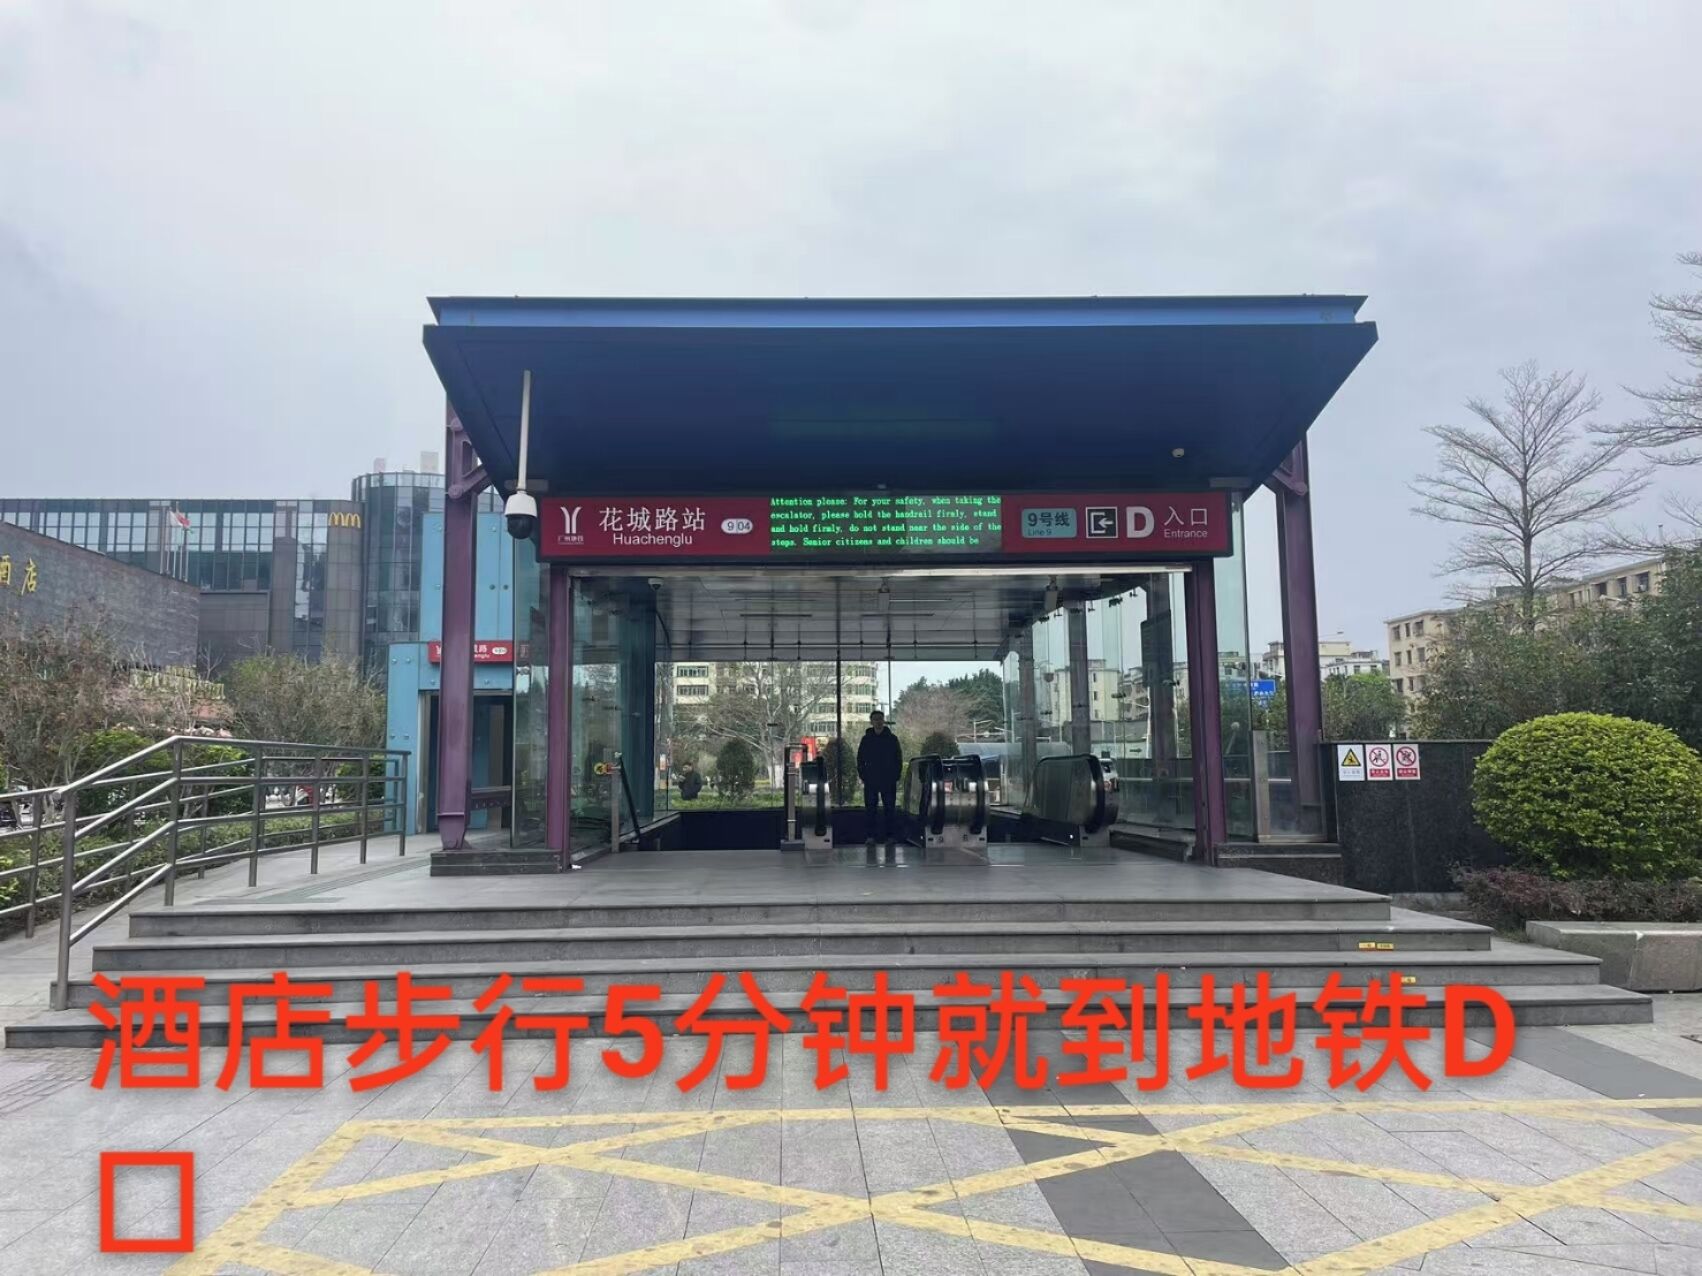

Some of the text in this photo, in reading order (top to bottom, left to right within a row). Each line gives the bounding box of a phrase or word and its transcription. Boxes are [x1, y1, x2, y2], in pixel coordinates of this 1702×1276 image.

[770, 497, 813, 506] Attention
[853, 496, 868, 506] For
[872, 498, 891, 507] your
[931, 496, 951, 504] when
[955, 496, 982, 506] taking
[987, 496, 1001, 504] the
[599, 507, 706, 531] 花城路站
[770, 511, 815, 520] escalator,
[821, 510, 850, 520] please
[854, 510, 872, 519] hold
[877, 510, 891, 518] the
[895, 510, 932, 518] handrail
[973, 509, 997, 518] stand
[1027, 511, 1070, 527] 9号线
[1164, 506, 1208, 526] 入口
[771, 524, 785, 532] and
[789, 524, 808, 532] hold
[849, 524, 859, 532] do
[863, 524, 877, 532] not
[882, 523, 905, 531] stand
[933, 523, 947, 531] the
[951, 523, 970, 531] side
[1126, 506, 1155, 538] D
[1028, 528, 1045, 536] Line
[1163, 529, 1208, 539] Entrance
[613, 533, 692, 547] Huachenglu
[803, 537, 831, 546] Senior
[836, 537, 873, 546] citizens
[877, 537, 892, 545] and
[895, 536, 934, 545] children
[938, 536, 965, 545] should
[969, 536, 980, 544] be
